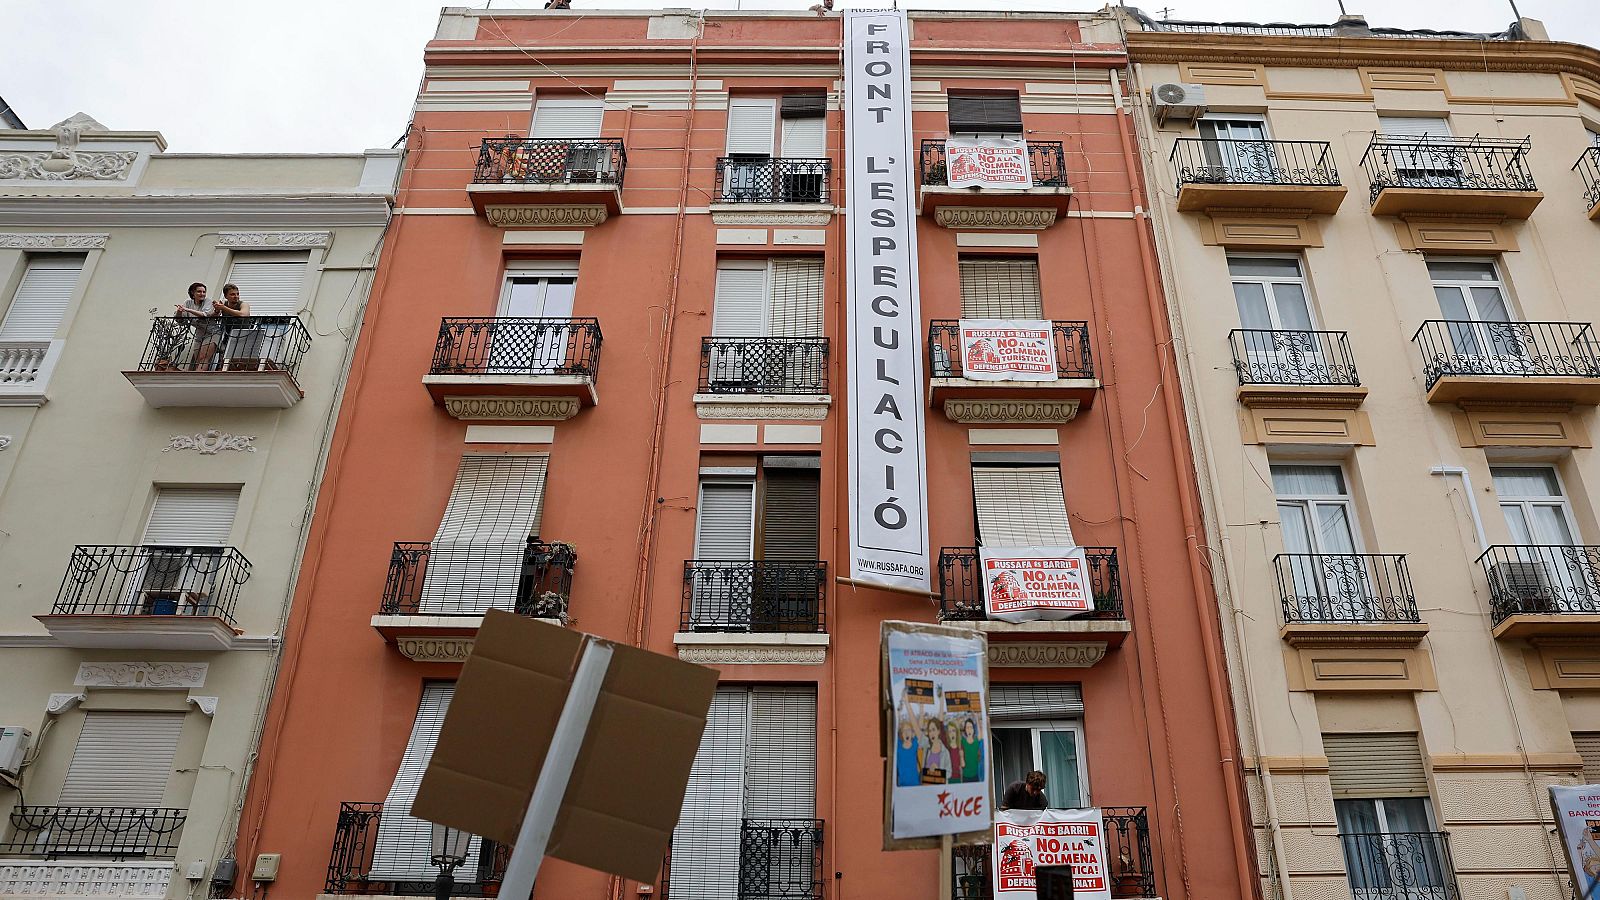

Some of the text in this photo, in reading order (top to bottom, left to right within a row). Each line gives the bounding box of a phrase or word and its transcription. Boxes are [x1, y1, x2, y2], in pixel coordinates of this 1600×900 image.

[978, 154, 995, 163] NO
[864, 23, 908, 530] FRONT L'ESPECULACIÓ
[997, 338, 1017, 348] NO
[999, 348, 1047, 356] COLMENA
[857, 558, 923, 575] WWW.RUSSAFA.ORG
[995, 561, 1032, 569] RUSSAFA
[1043, 561, 1072, 569] BARRI!
[1023, 570, 1046, 581] NO
[1025, 582, 1079, 590] COLMENA
[998, 601, 1039, 609] DEFENSEM
[894, 667, 922, 675] BANCOS
[930, 668, 957, 676] FONDOS
[1006, 826, 1045, 836] RUSSAFA
[1058, 825, 1089, 835] BARRI!
[1036, 838, 1084, 852] NO A LA
[1038, 853, 1097, 864] COLMENA
[1072, 866, 1098, 874] TICA!
[1008, 879, 1036, 887] DEFEN
